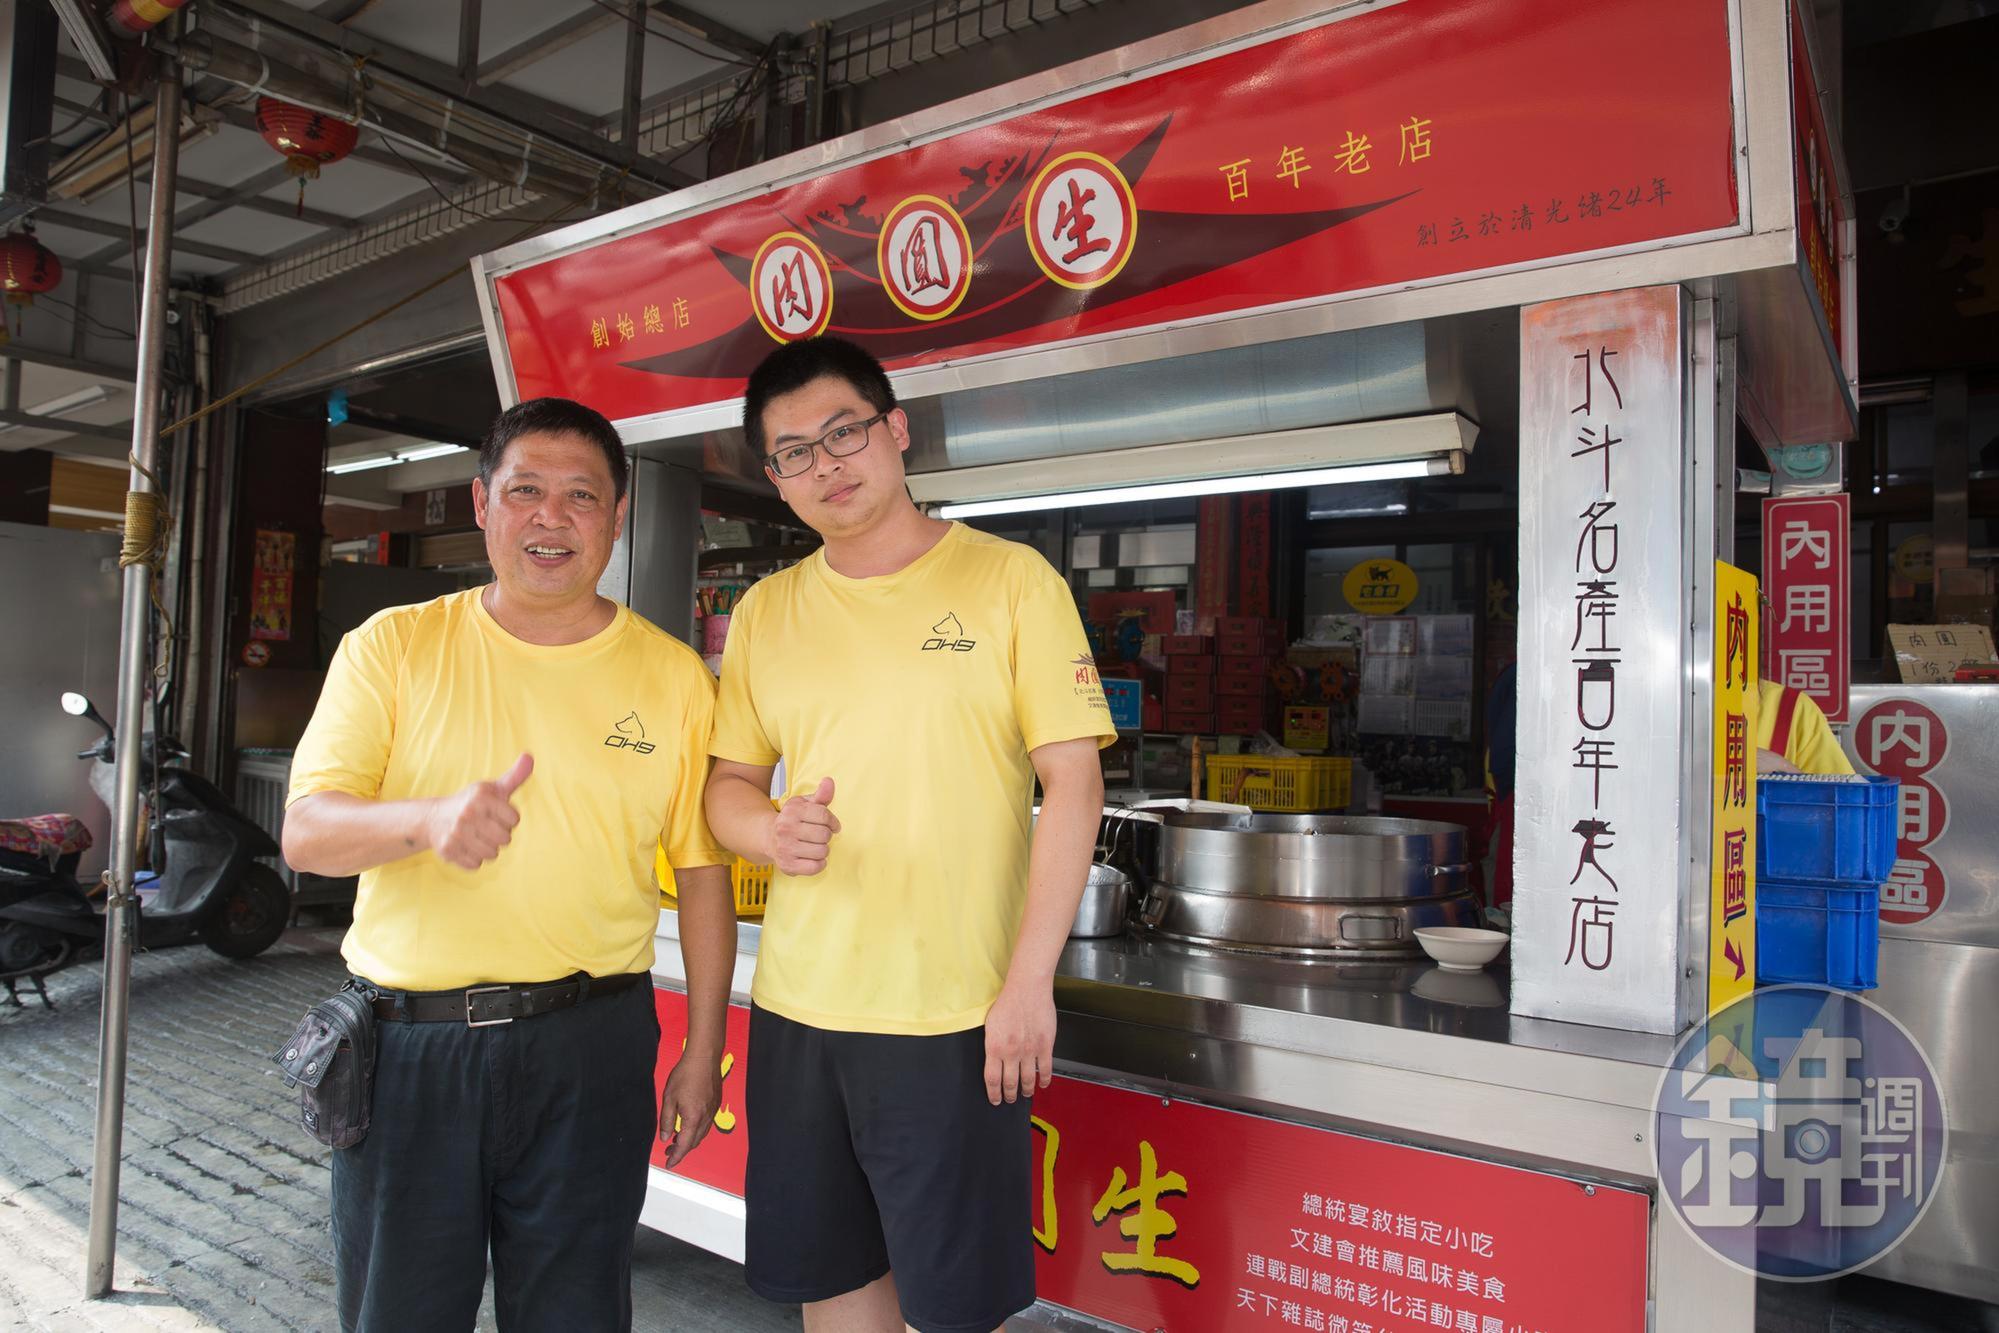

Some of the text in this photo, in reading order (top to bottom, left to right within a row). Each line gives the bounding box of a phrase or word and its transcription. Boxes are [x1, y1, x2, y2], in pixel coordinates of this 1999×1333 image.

[1219, 116, 1435, 203] 百年老店
[591, 297, 690, 349] 創始總店
[1565, 344, 1623, 971] 北斗名產百年老店
[1302, 1192, 1494, 1259] 總統宴敘指定小吃
[1246, 1252, 1550, 1333] 連戰副總統彰化活動專屬
[1290, 1227, 1506, 1303] 文建會推薦風味美食
